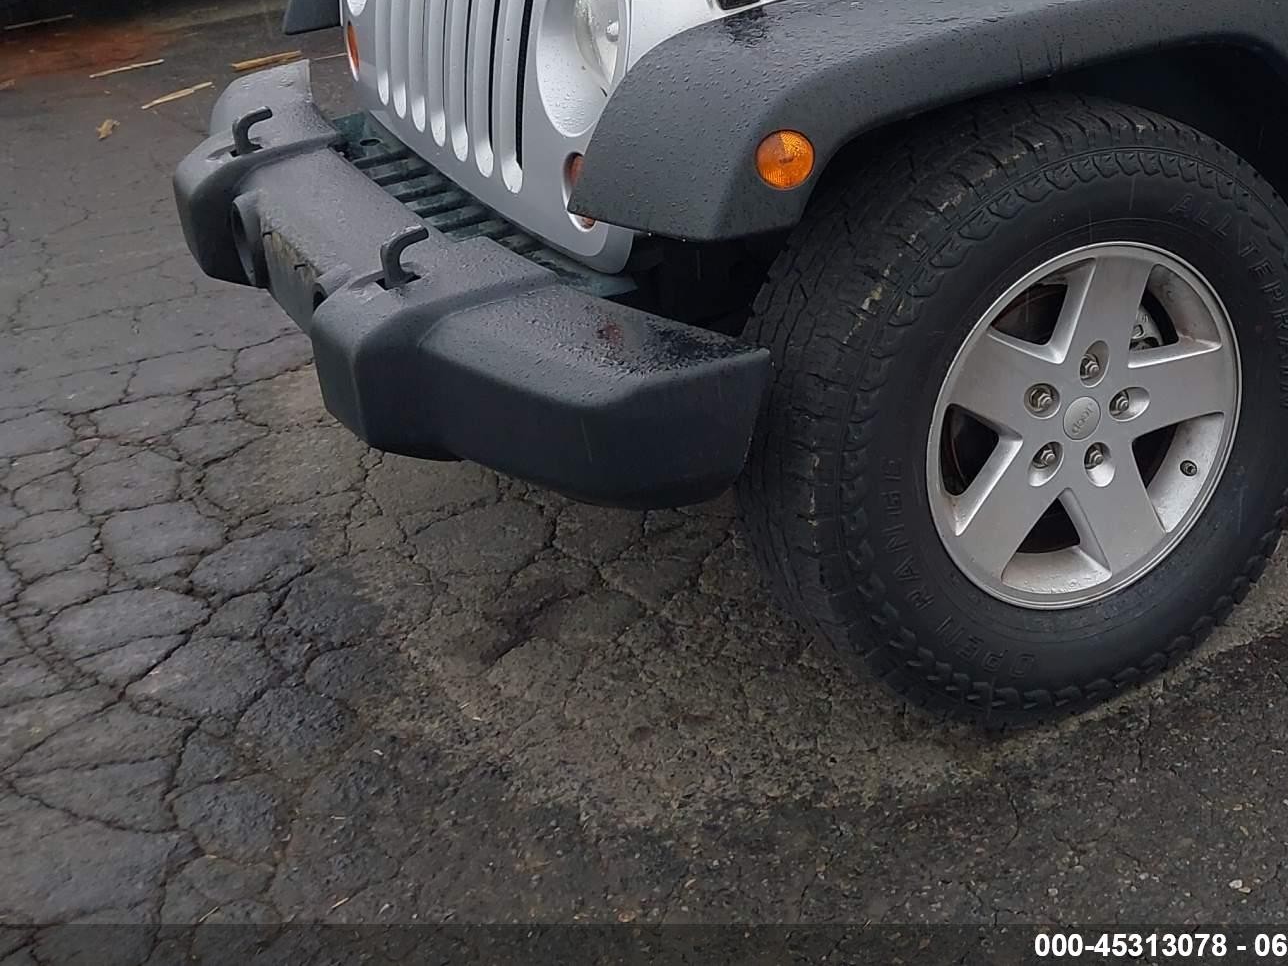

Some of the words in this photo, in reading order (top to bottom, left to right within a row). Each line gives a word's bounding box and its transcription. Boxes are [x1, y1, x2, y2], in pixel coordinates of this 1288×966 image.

[1167, 193, 1232, 237] ALL
[879, 456, 935, 611] RANGE
[935, 614, 1036, 679] OPEN
